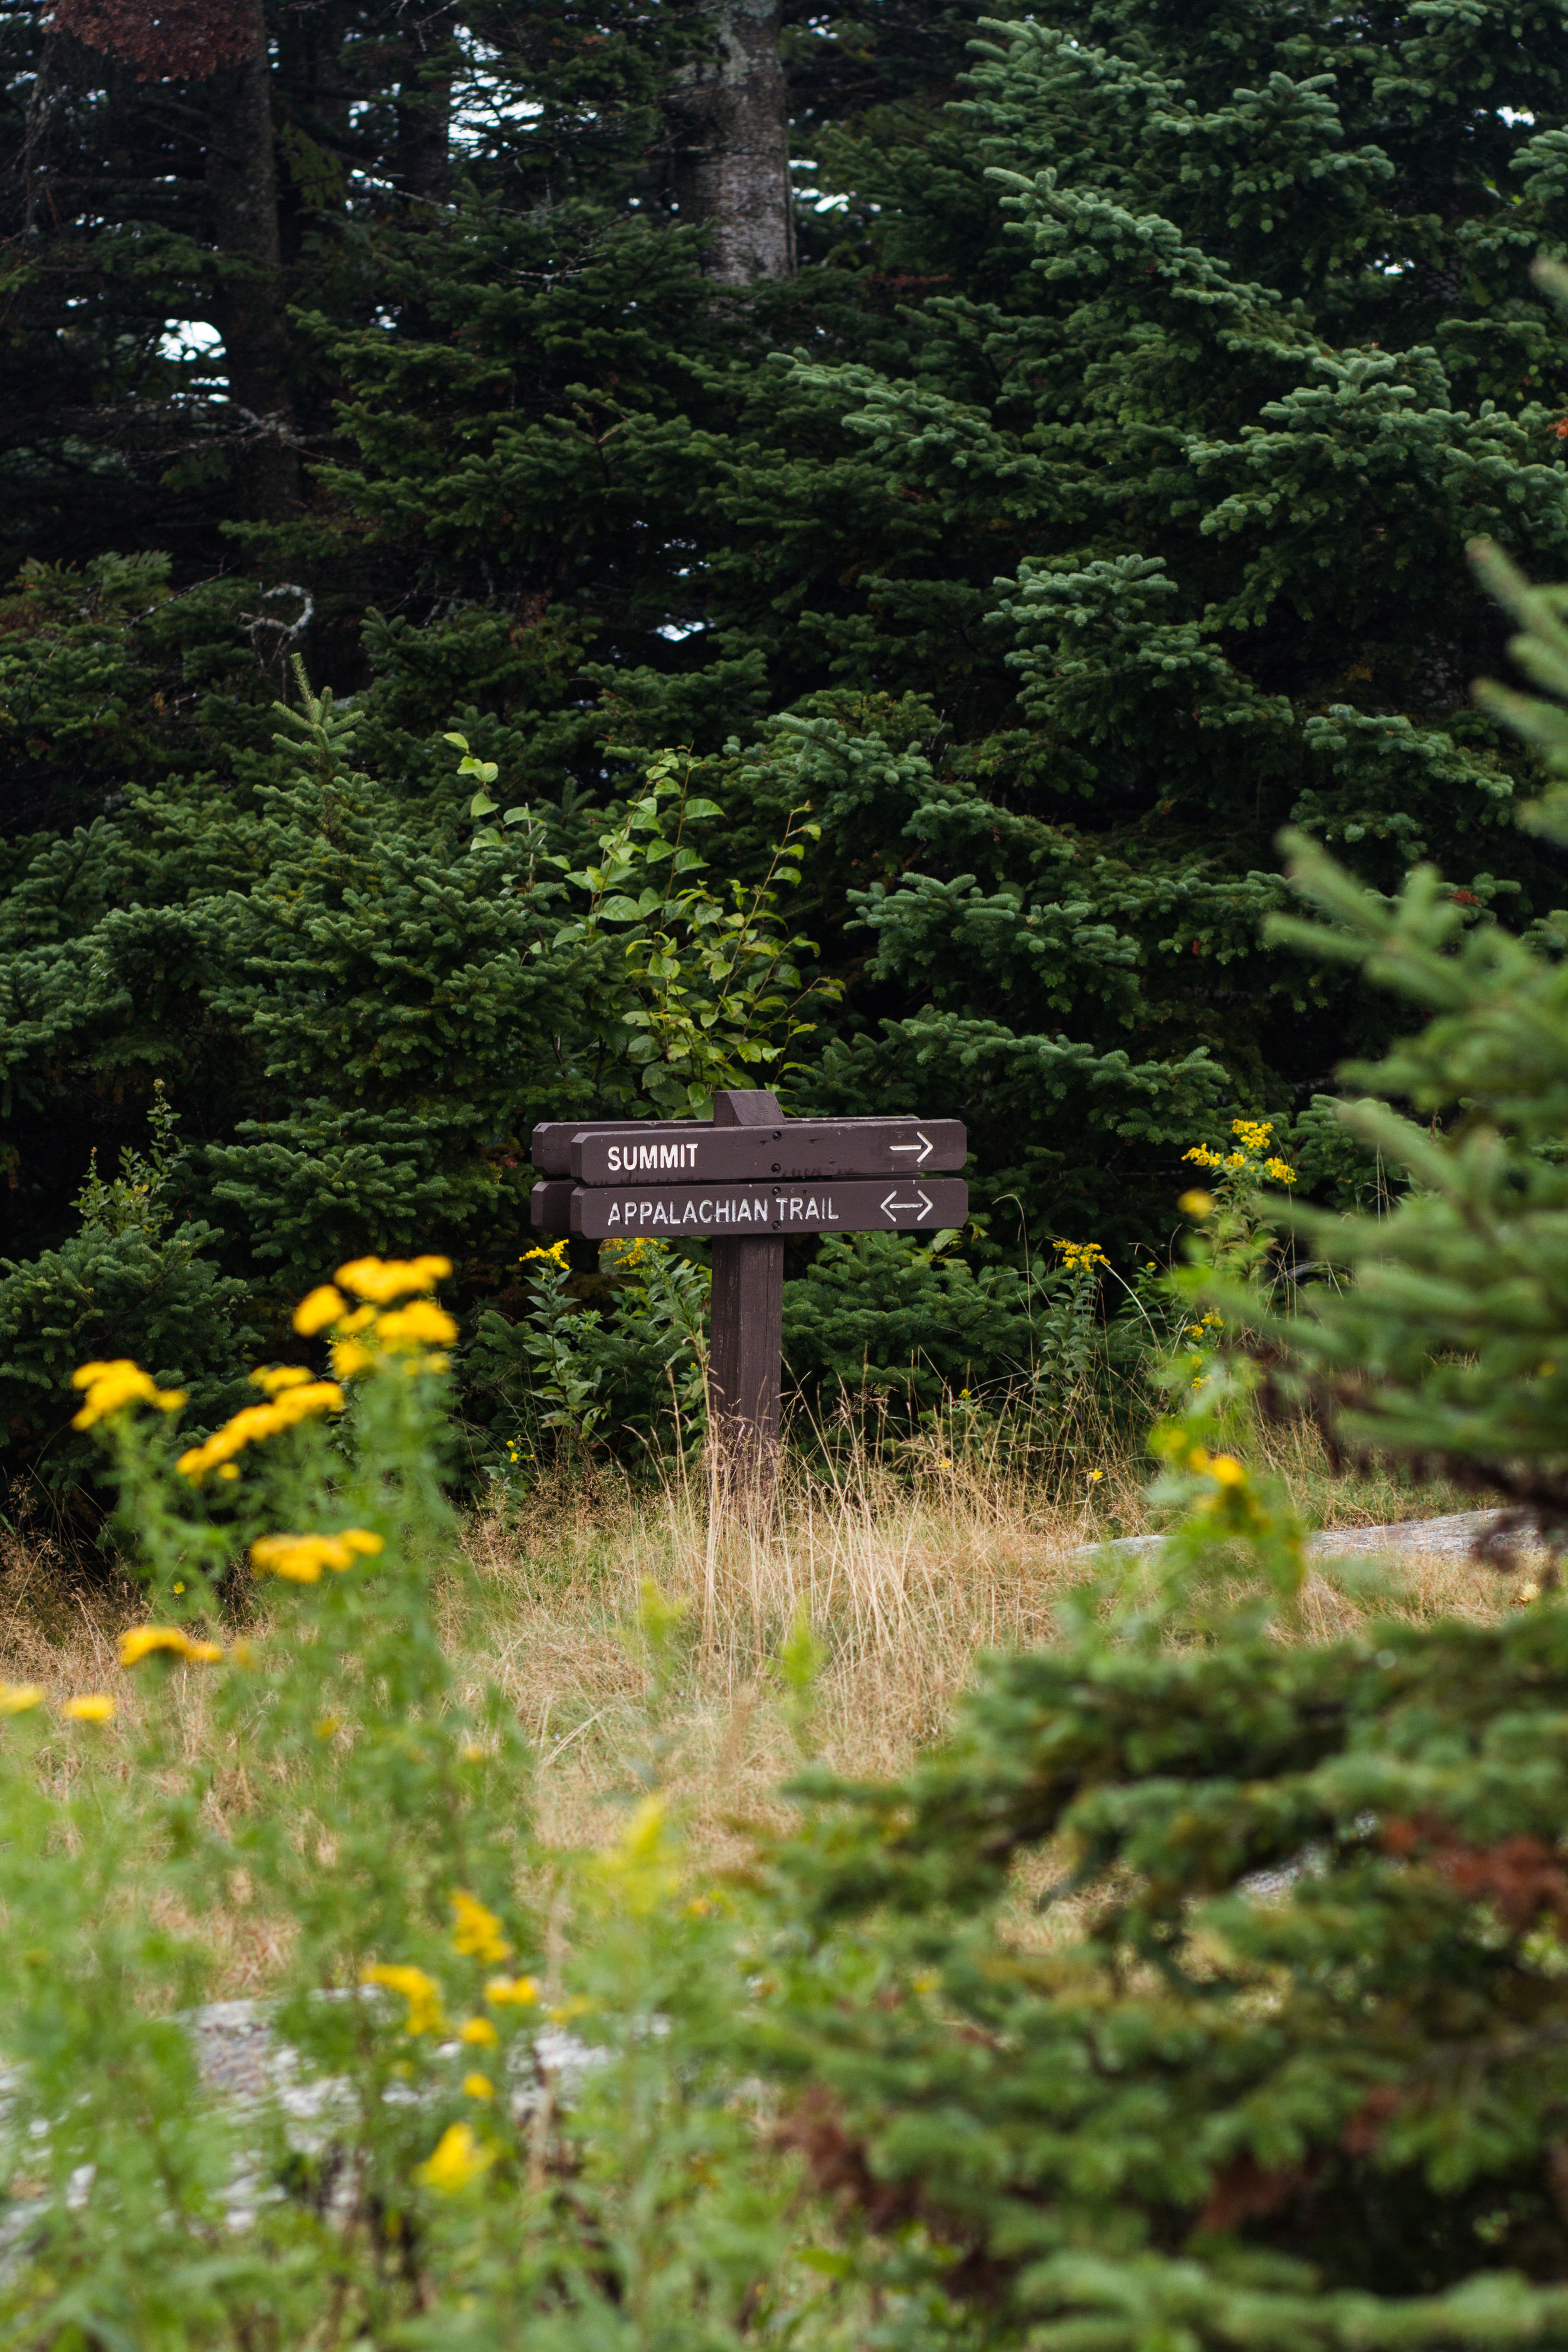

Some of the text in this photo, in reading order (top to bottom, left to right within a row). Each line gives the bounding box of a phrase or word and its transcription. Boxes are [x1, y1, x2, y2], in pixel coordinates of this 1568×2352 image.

[607, 1143, 699, 1172] SUMMIT
[607, 1196, 840, 1226] APPALACHIAN TRAIL
